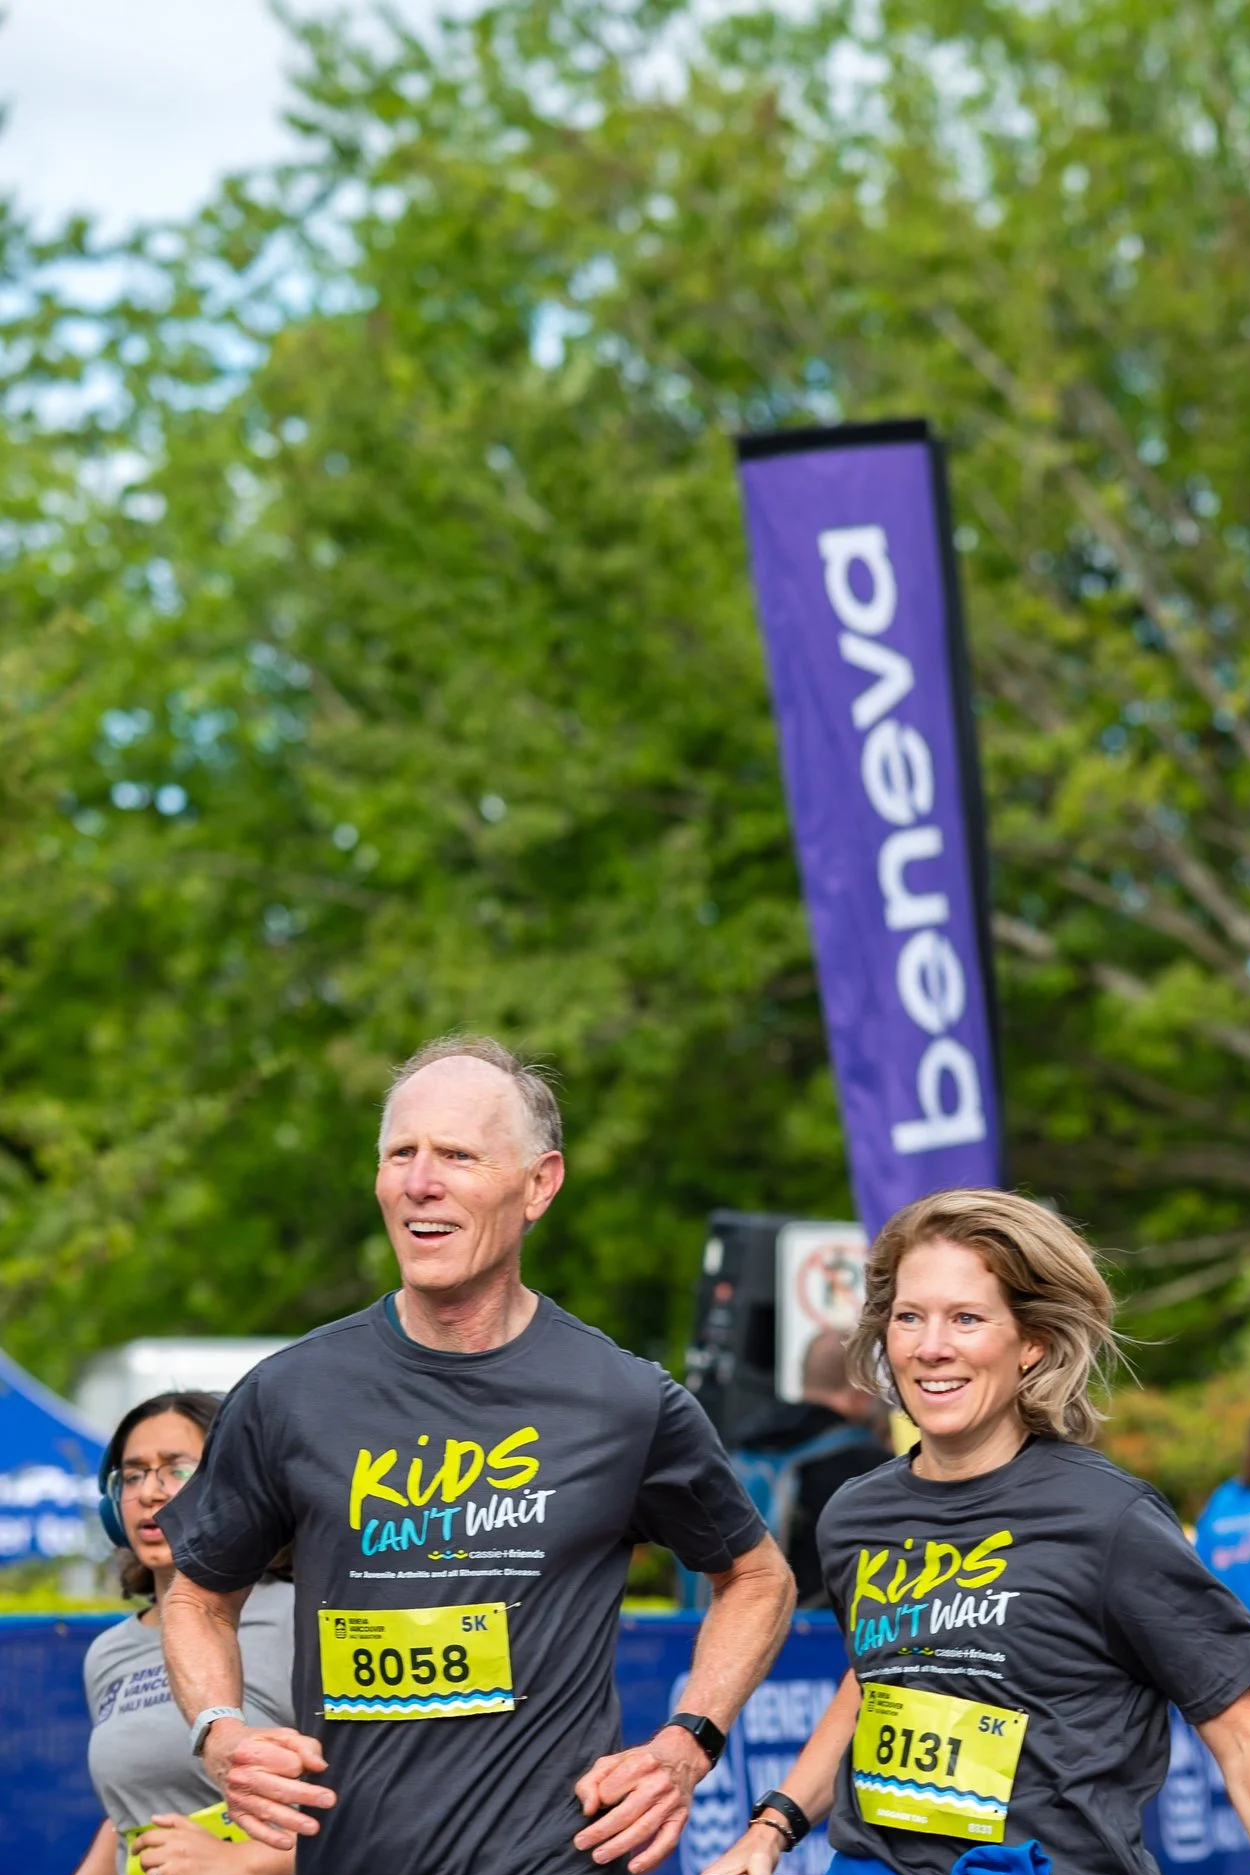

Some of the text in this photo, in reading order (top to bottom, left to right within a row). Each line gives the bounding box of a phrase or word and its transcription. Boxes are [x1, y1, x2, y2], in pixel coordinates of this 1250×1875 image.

[817, 523, 987, 1155] beneva
[361, 1507, 462, 1556] CAN'T
[461, 1614, 488, 1633] 5K
[854, 1603, 930, 1657] CAN'T
[352, 1643, 471, 1687] 8058
[977, 1714, 1007, 1737] 5K
[876, 1724, 963, 1778] 8131
